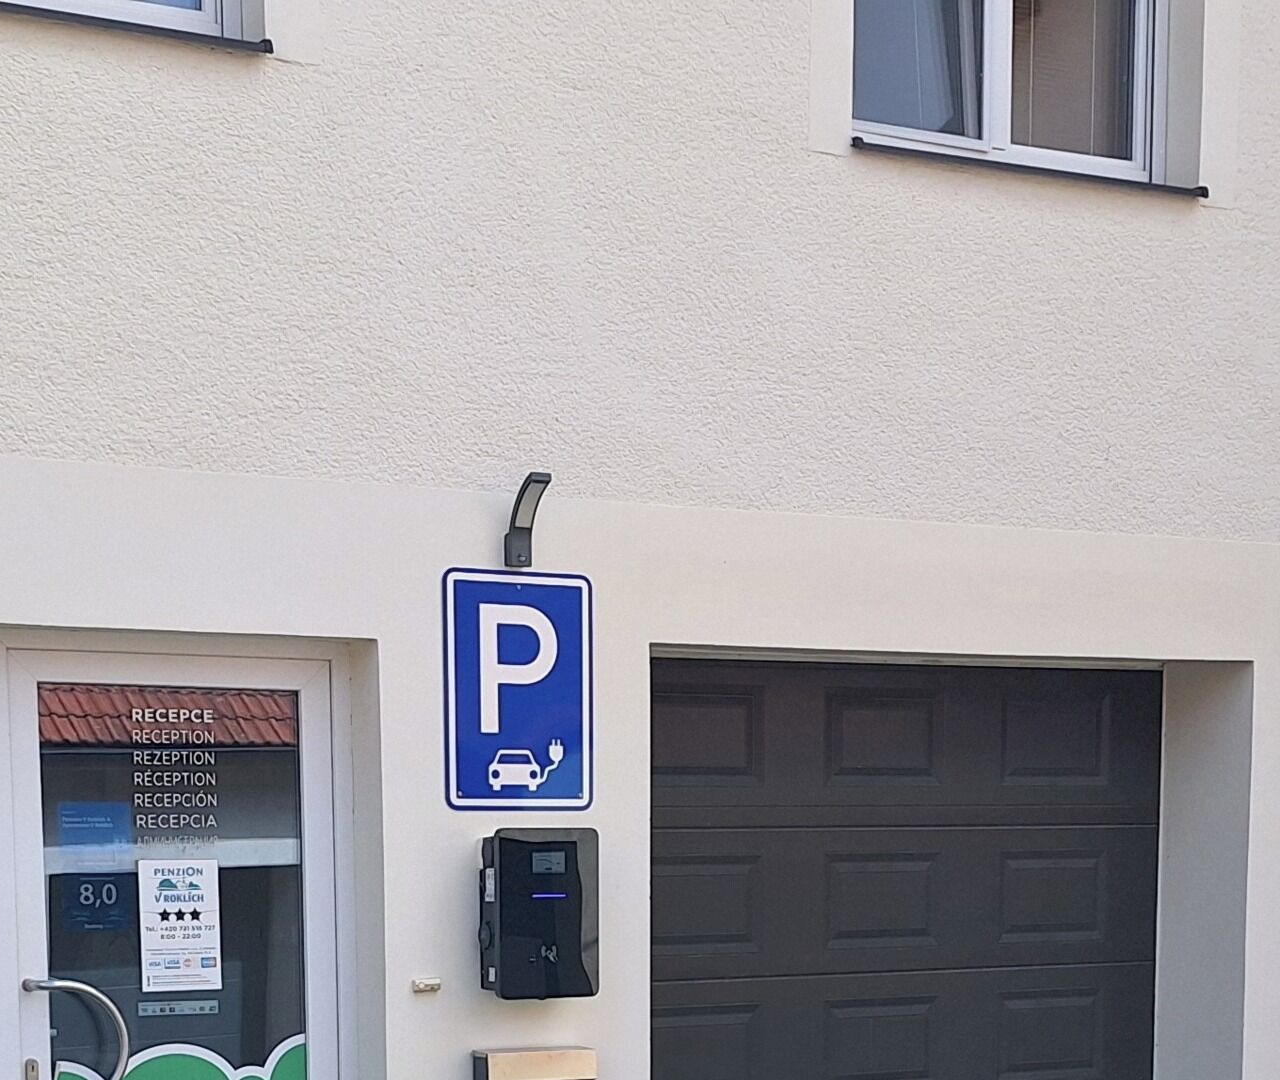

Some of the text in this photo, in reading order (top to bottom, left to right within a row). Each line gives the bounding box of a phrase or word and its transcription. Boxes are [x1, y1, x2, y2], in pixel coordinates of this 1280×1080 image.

[480, 603, 558, 733] P
[131, 708, 214, 723] RECEPCE
[132, 729, 215, 744] RECEPTION
[133, 751, 215, 765] REZEPTION
[134, 769, 217, 786] RÉCEPTION
[134, 790, 218, 807] RECEPCIÓN
[136, 814, 218, 828] RECEPCIA
[153, 866, 204, 877] PENZION
[79, 883, 117, 908] 8,0
[154, 891, 204, 903] V ROKLÍCH
